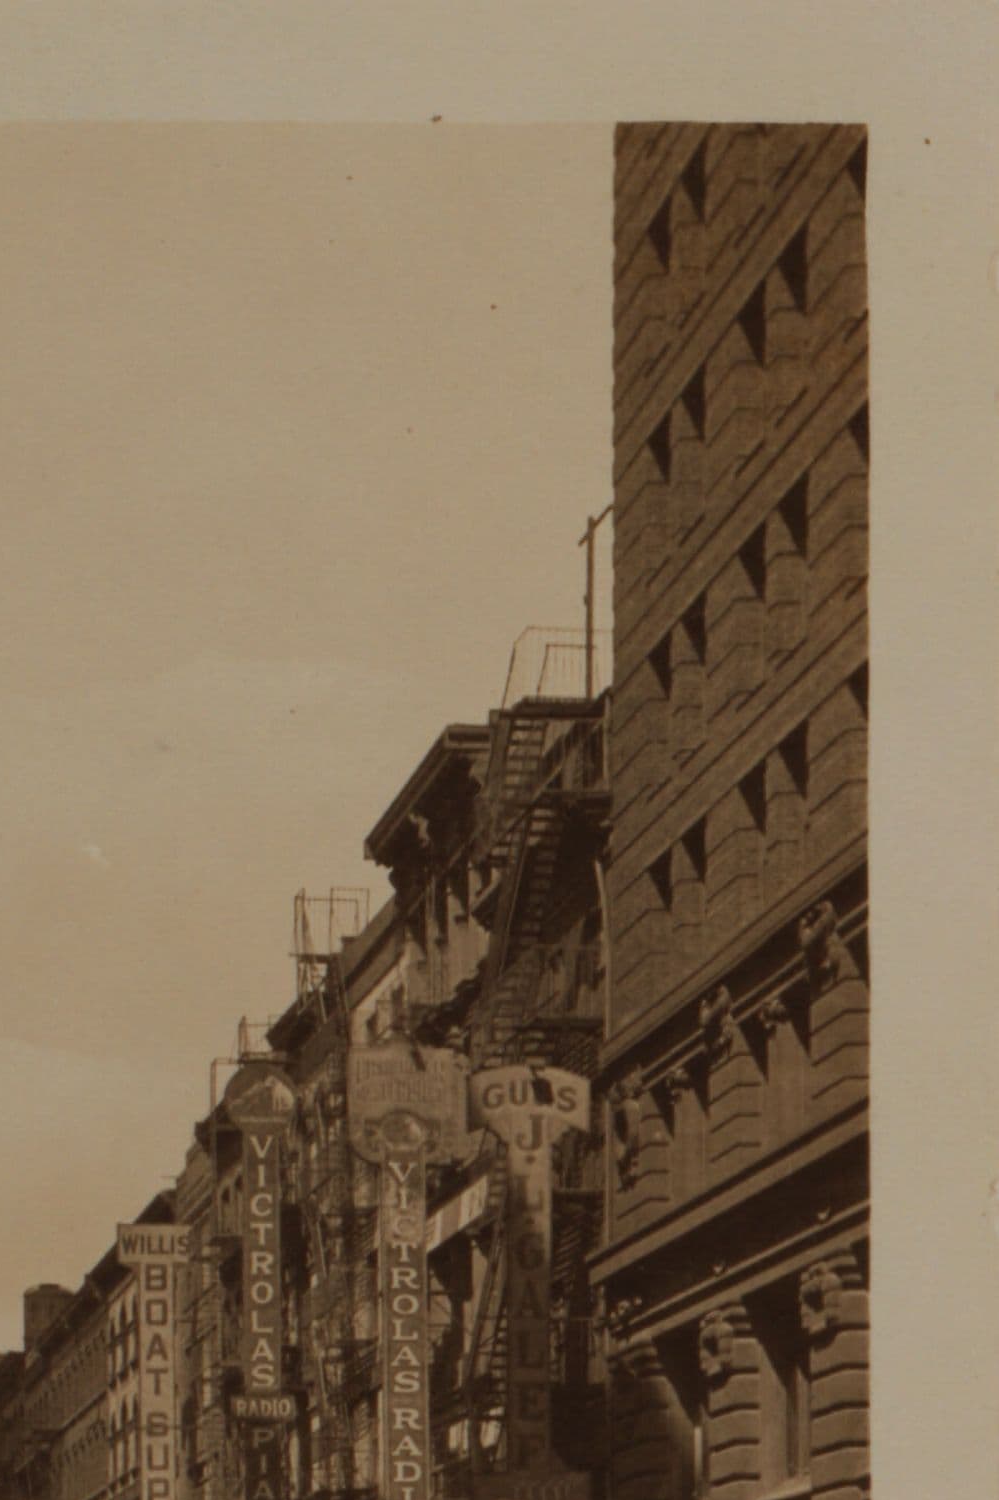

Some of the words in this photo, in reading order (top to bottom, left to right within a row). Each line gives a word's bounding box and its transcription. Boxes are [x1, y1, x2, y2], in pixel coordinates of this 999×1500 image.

[482, 1082, 578, 1112] GUS
[120, 1233, 190, 1255] WILLIS
[247, 1134, 278, 1388] VICTROLAS
[388, 1160, 423, 1394] VICTROLAS
[145, 1263, 170, 1391] BOAT
[234, 1397, 292, 1418] RADIO
